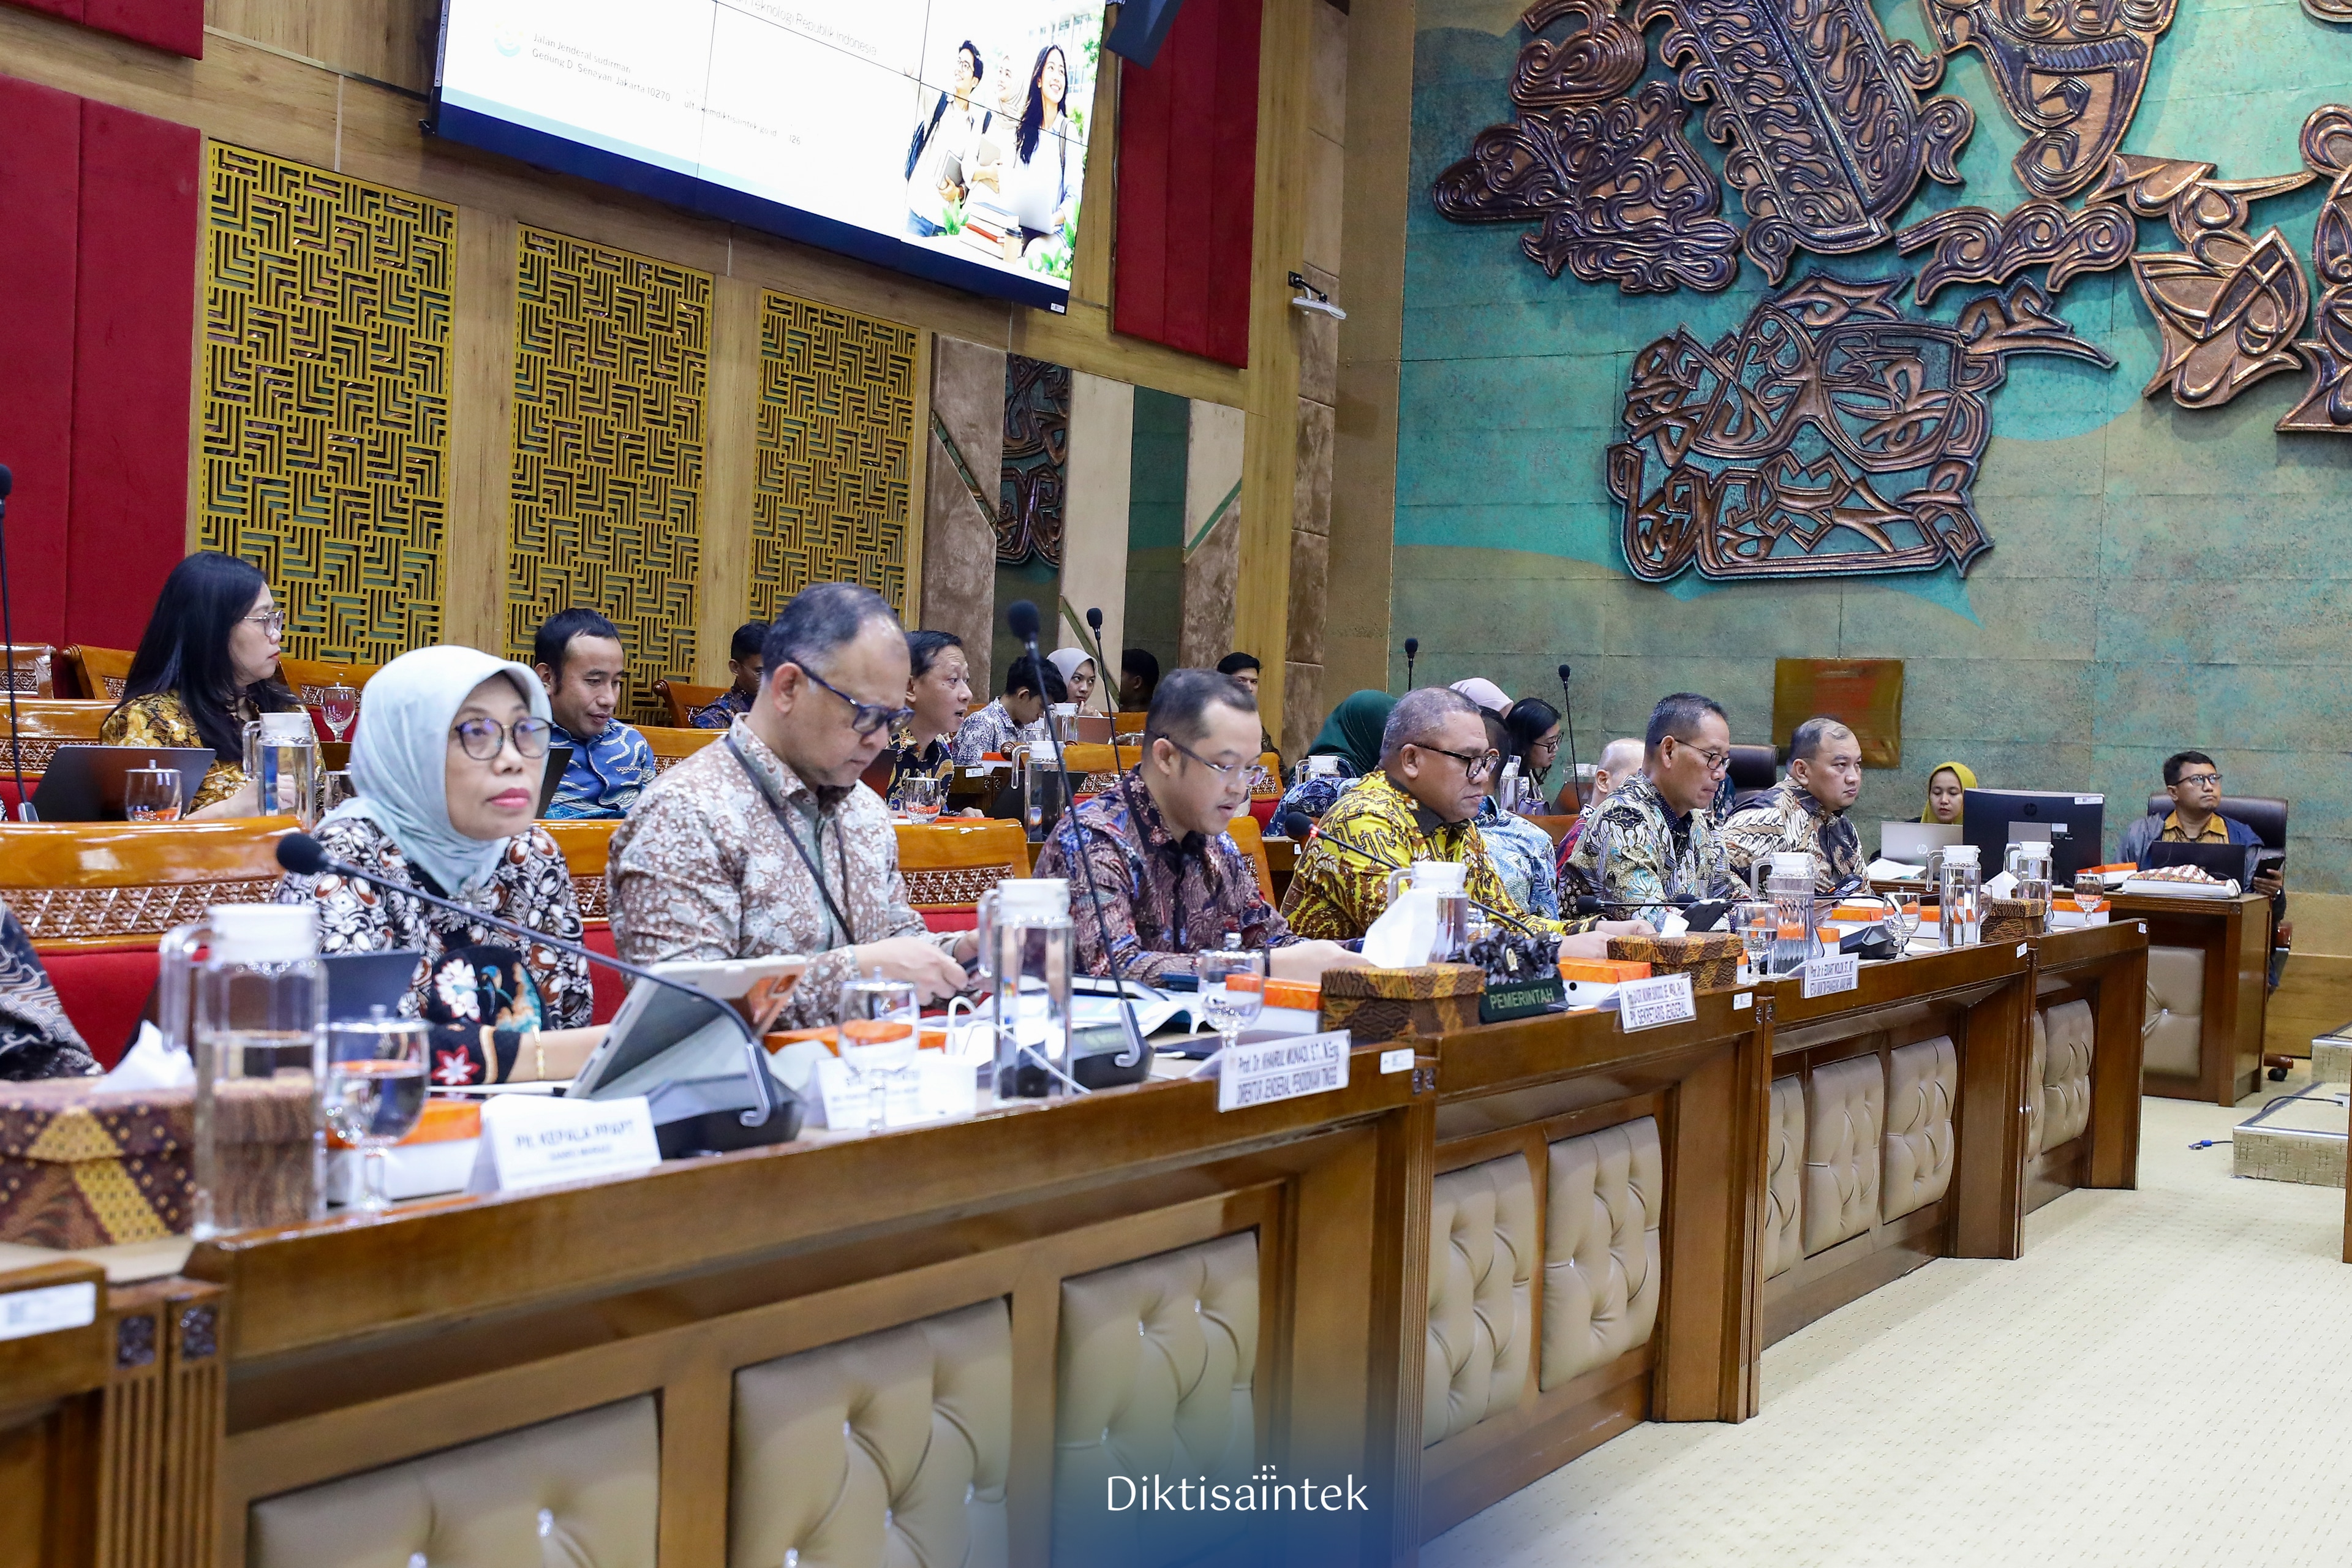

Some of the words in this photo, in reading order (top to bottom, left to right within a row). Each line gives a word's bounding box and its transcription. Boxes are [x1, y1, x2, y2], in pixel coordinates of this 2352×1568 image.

[533, 33, 556, 48] Jalan
[557, 41, 592, 61] Jenderal
[796, 13, 834, 39] Republik
[836, 30, 877, 56] Indonesia
[532, 48, 565, 69] Gedung
[616, 77, 646, 93] Jakarta
[647, 86, 671, 102] 10270
[789, 134, 801, 145] 126
[1489, 987, 1555, 1010] PEMERINTAH
